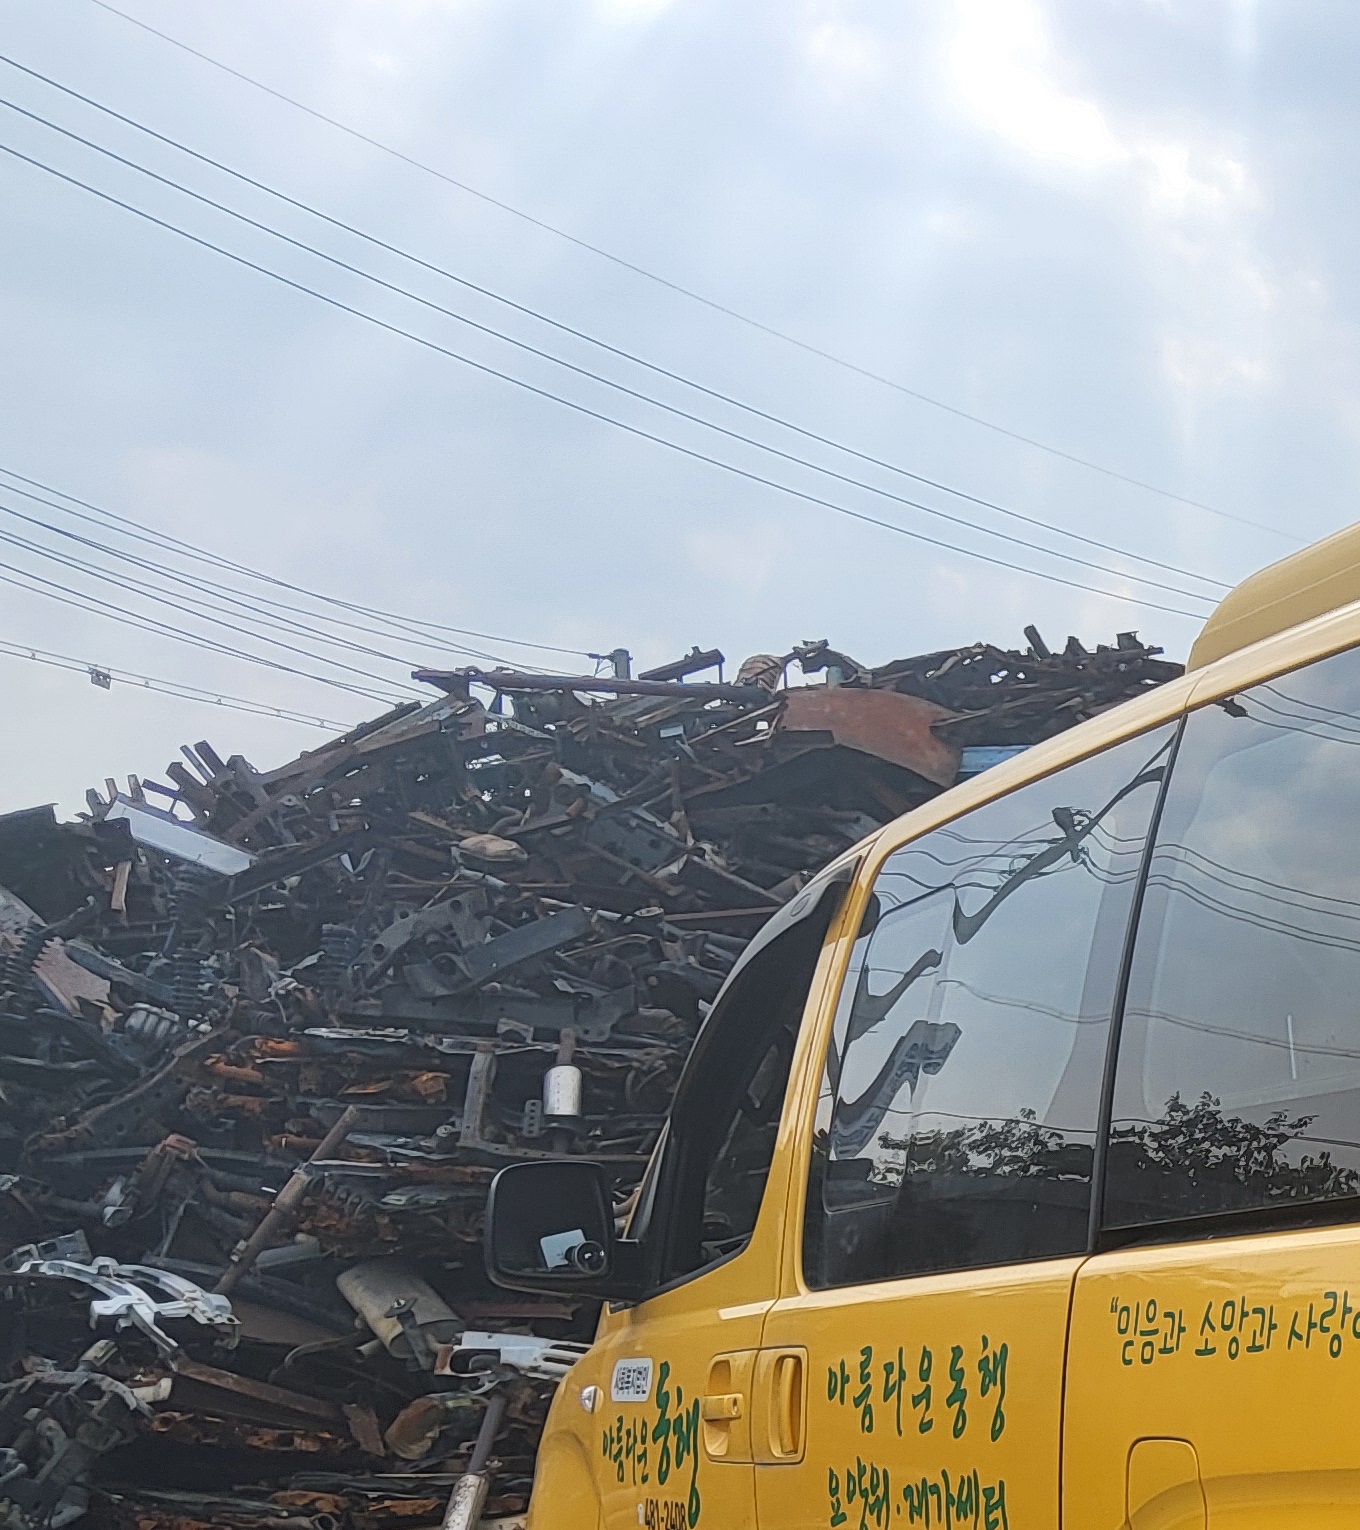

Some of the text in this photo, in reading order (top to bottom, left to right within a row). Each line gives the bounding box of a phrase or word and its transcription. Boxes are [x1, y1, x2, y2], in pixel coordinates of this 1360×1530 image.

[1195, 1295, 1277, 1361] 소망과
[602, 1360, 701, 1530] 아름다운 동행
